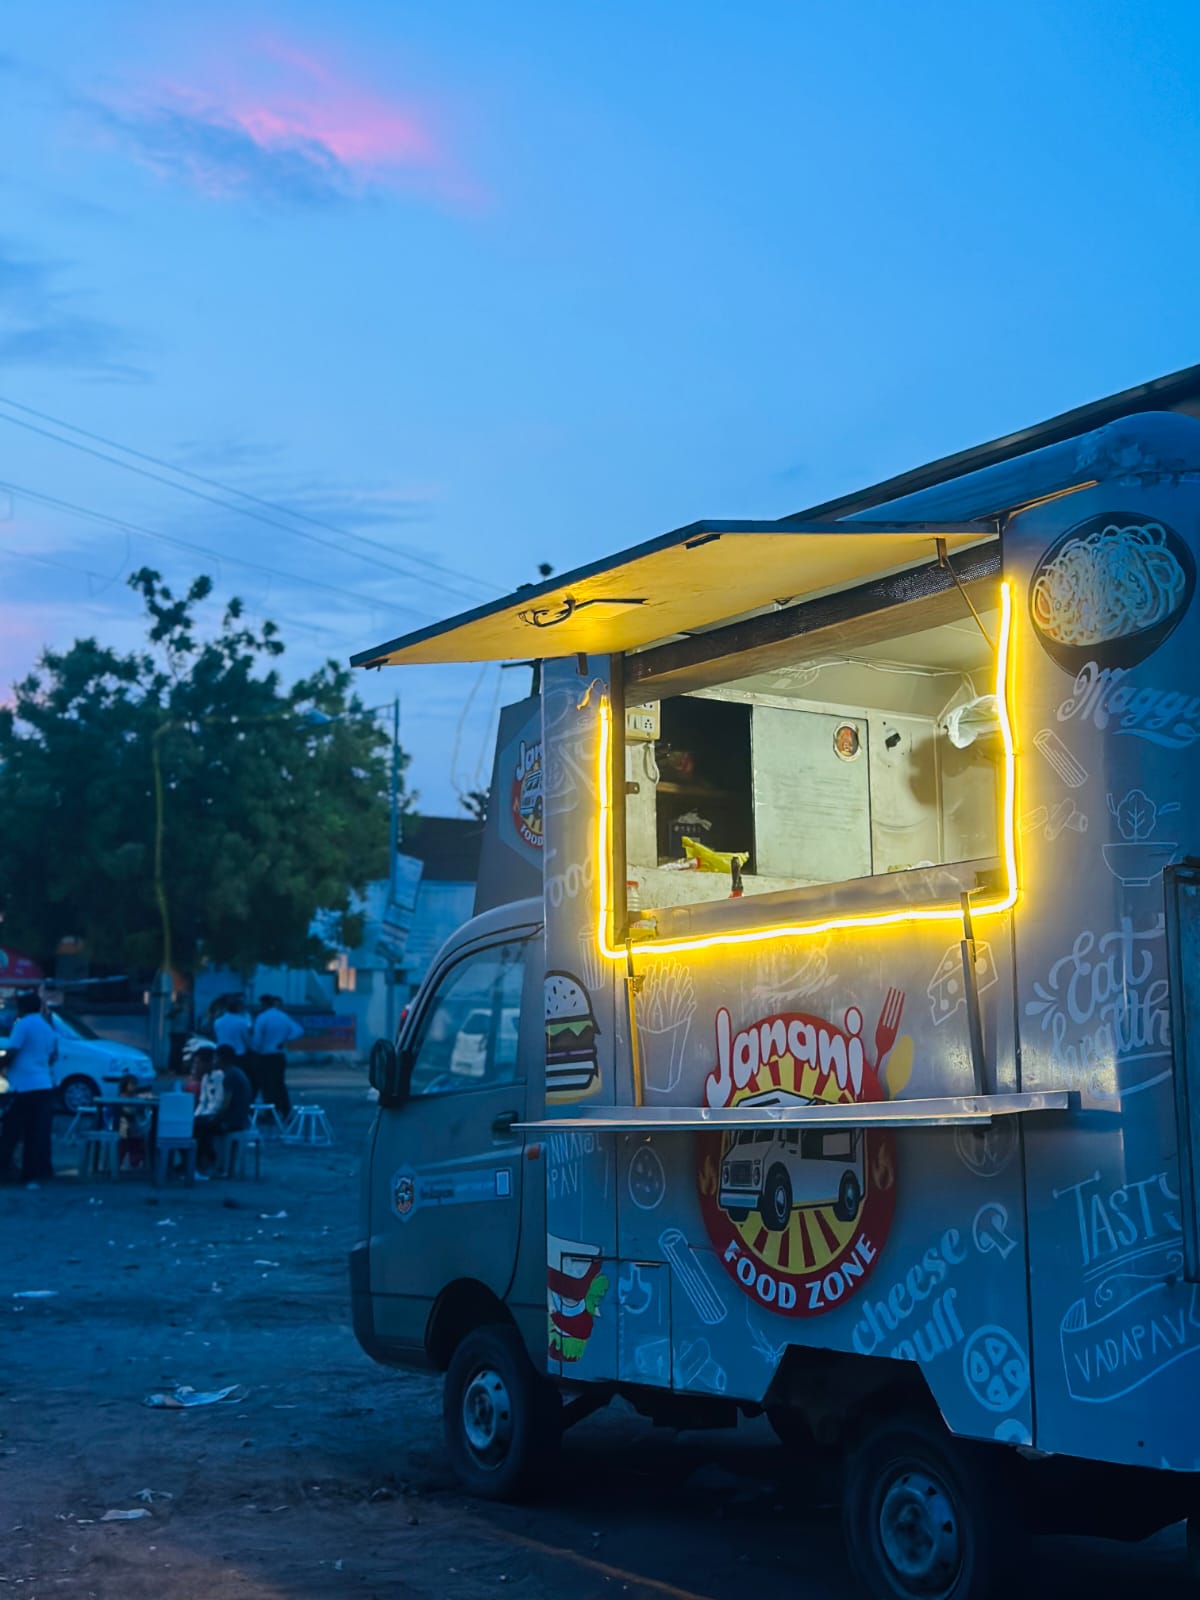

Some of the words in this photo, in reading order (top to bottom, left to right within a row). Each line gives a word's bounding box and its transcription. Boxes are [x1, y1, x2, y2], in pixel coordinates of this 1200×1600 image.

[1049, 913, 1165, 1024] Eat
[705, 1007, 864, 1107] Janani
[724, 1240, 797, 1309] FOOD
[805, 1233, 876, 1309] ZONE
[852, 1228, 968, 1355] cheese
